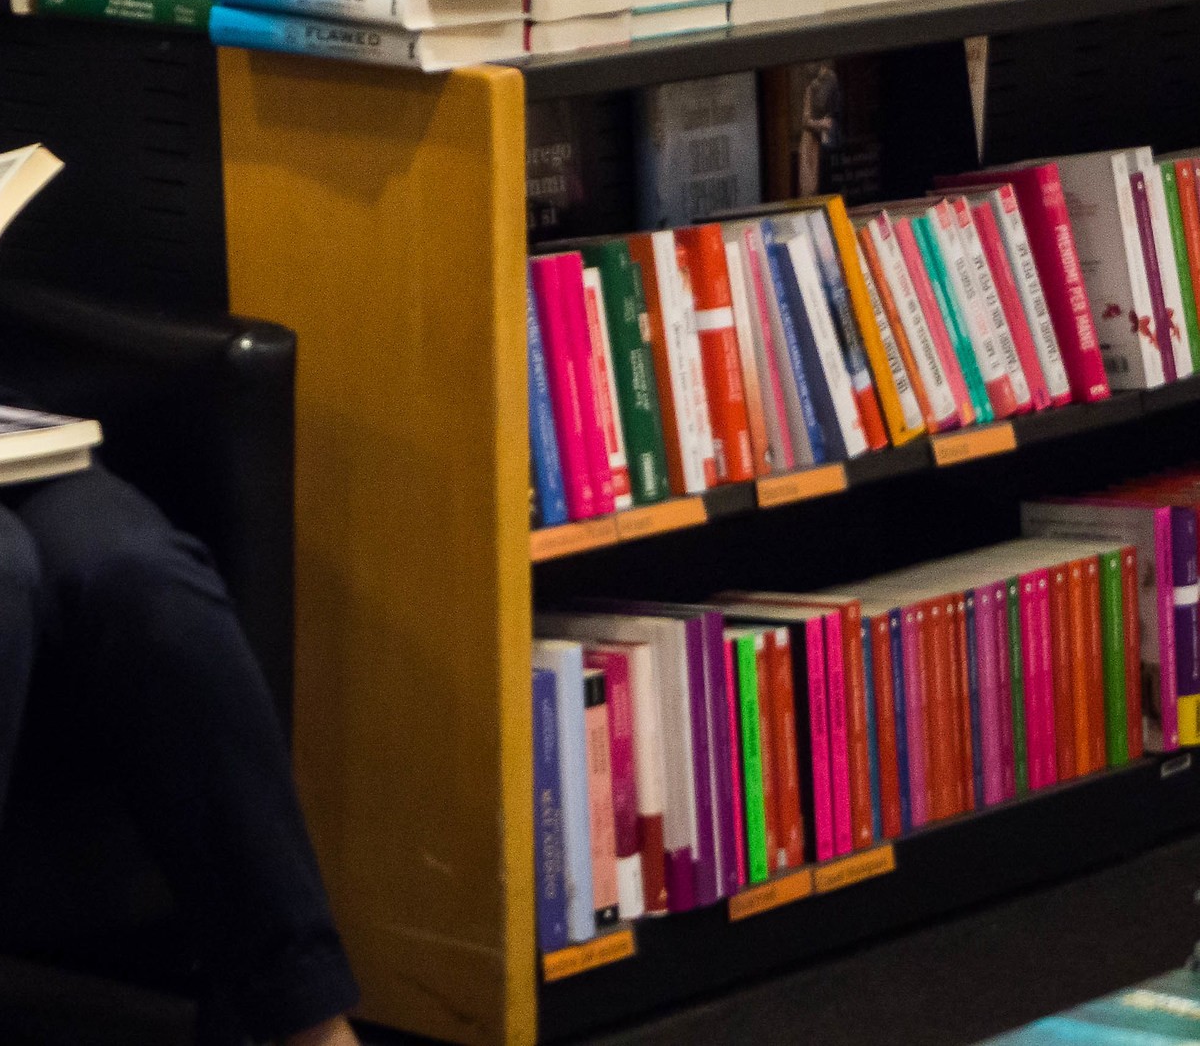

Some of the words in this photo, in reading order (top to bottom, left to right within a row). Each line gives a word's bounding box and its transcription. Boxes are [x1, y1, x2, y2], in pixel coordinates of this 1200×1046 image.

[305, 26, 381, 47] FLAWED
[528, 144, 572, 169] rego
[1014, 240, 1028, 257] ME
[1055, 224, 1080, 286] PRENDIMI
[970, 252, 986, 269] ME
[1020, 258, 1034, 279] PER
[976, 270, 993, 292] PER
[1026, 279, 1039, 294] FA
[983, 291, 998, 307] FA
[1031, 293, 1047, 318] NON
[1069, 289, 1087, 312] PER
[988, 305, 1005, 329] NON
[1040, 320, 1059, 363] L'AMORE
[1076, 314, 1096, 351] MANO
